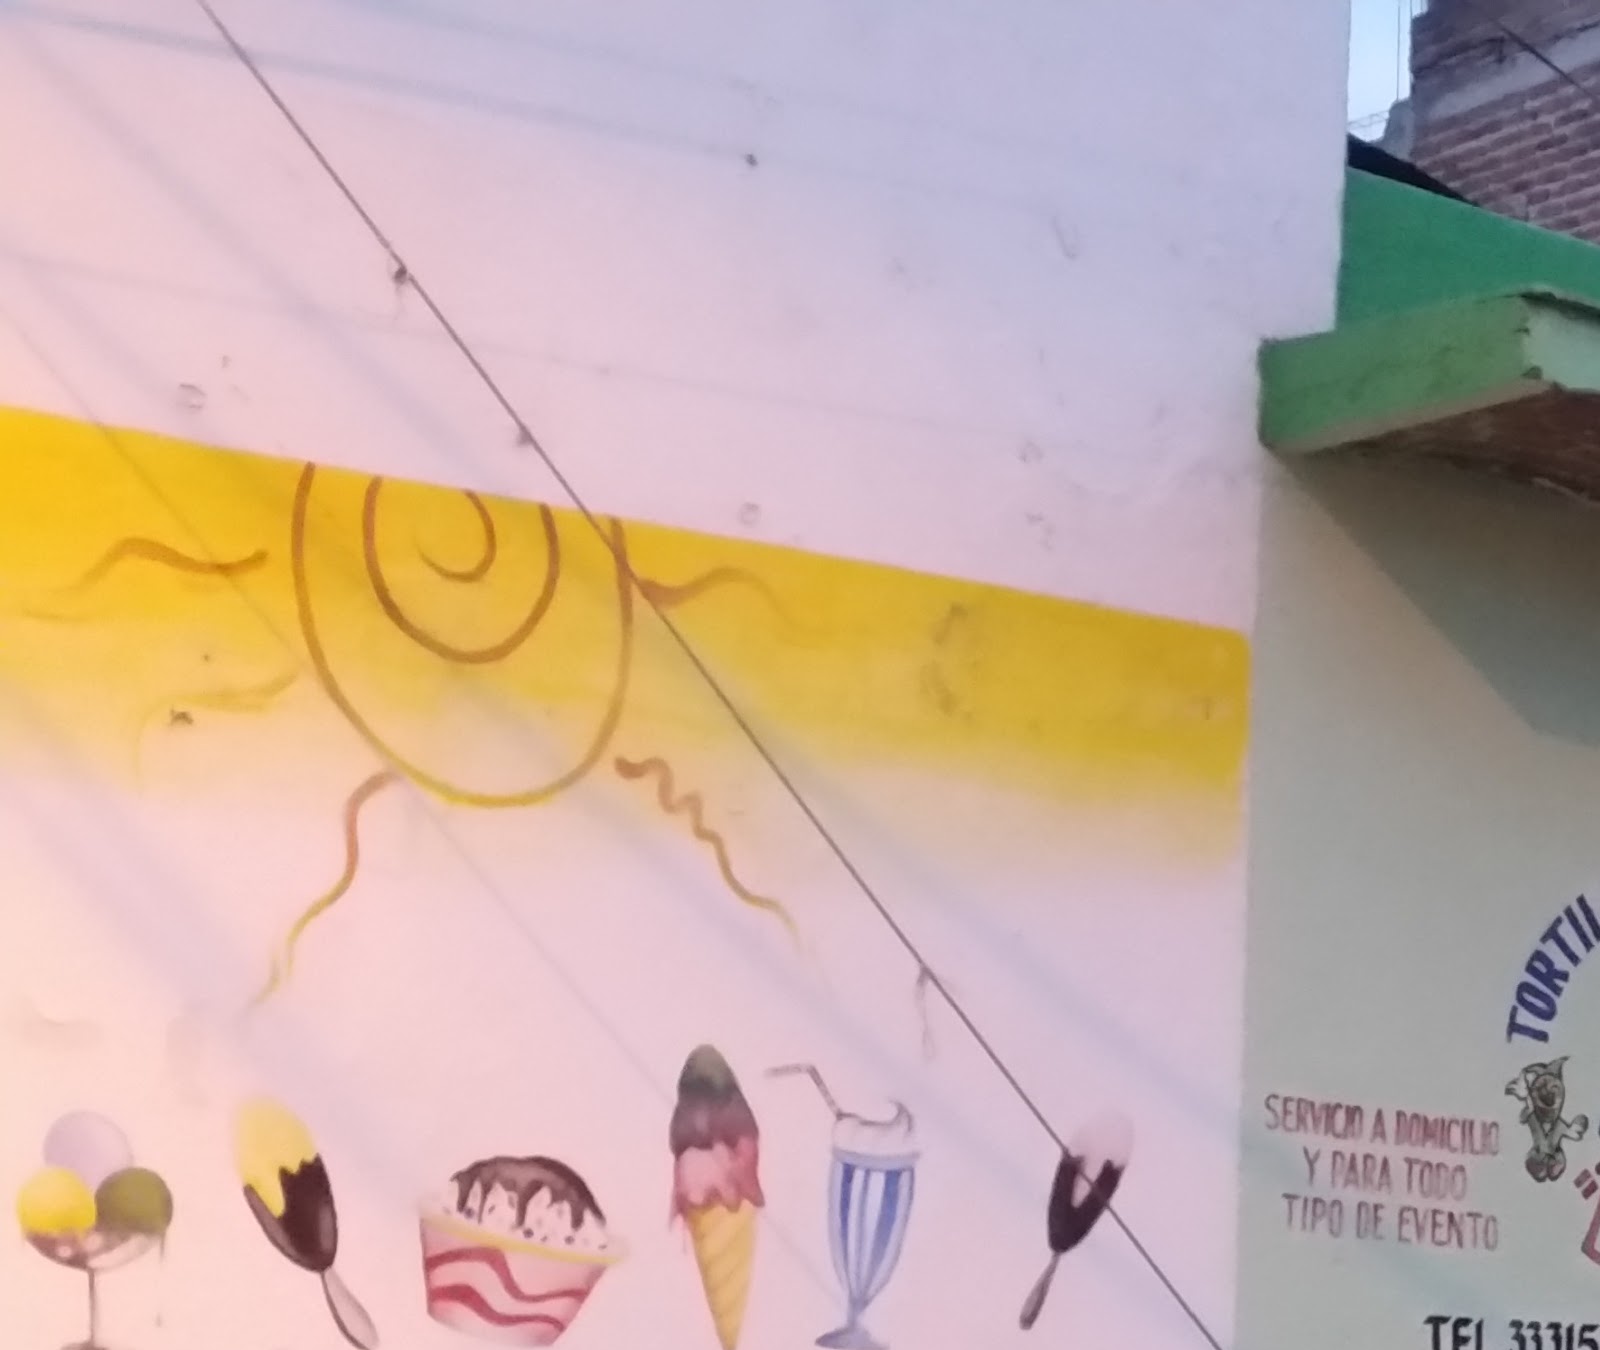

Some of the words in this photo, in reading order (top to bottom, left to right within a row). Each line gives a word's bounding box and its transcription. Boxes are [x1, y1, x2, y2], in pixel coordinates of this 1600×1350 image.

[1264, 1094, 1364, 1140] SERVICIO
[1370, 1108, 1387, 1144] A
[1394, 1110, 1501, 1156] DOMICILIO
[1303, 1146, 1321, 1187] Y
[1331, 1150, 1392, 1193] PARA
[1403, 1156, 1467, 1201] TODO
[1281, 1192, 1344, 1239] TIPO
[1356, 1200, 1385, 1240] DE
[1398, 1206, 1499, 1251] EVENTO
